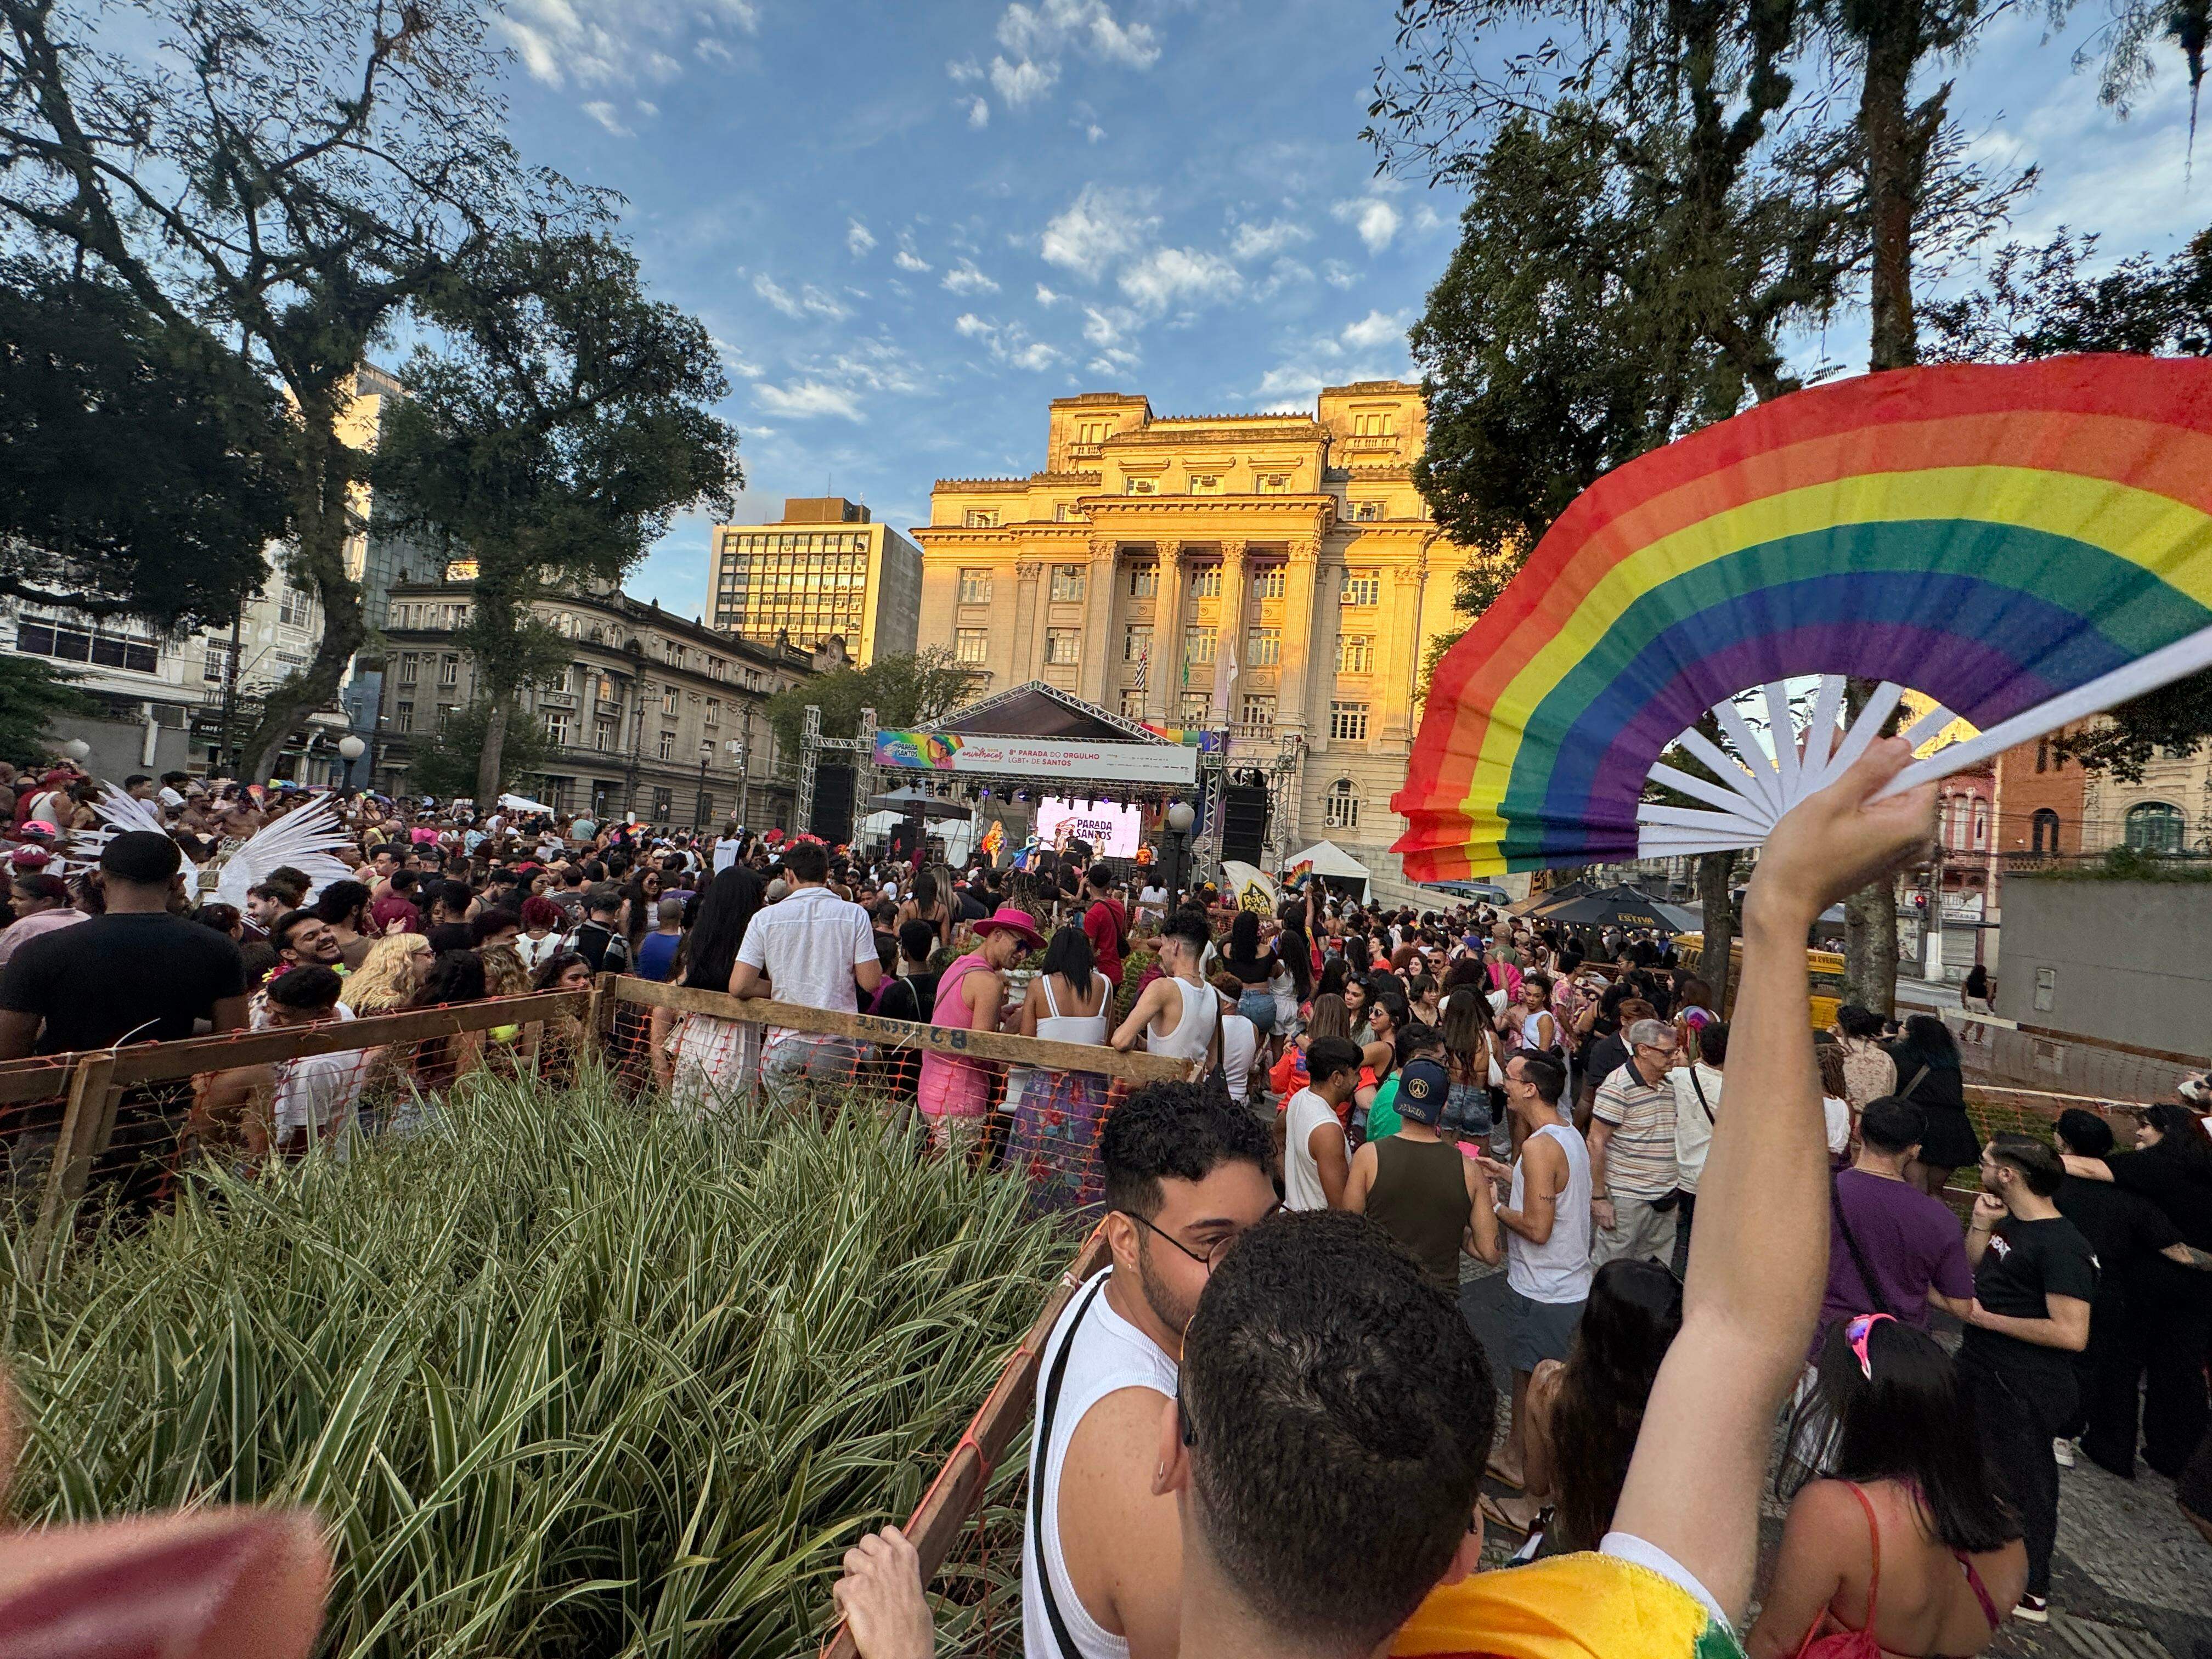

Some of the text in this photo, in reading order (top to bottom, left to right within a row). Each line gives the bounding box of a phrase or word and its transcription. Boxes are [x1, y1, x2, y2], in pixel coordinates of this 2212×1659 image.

[1077, 819, 1113, 831] PARADA
[1076, 829, 1112, 840] SANOS
[1243, 894, 1266, 905] Rota
[1618, 915, 1655, 924] ESTIVA
[1397, 1103, 1426, 1119] PARIS
